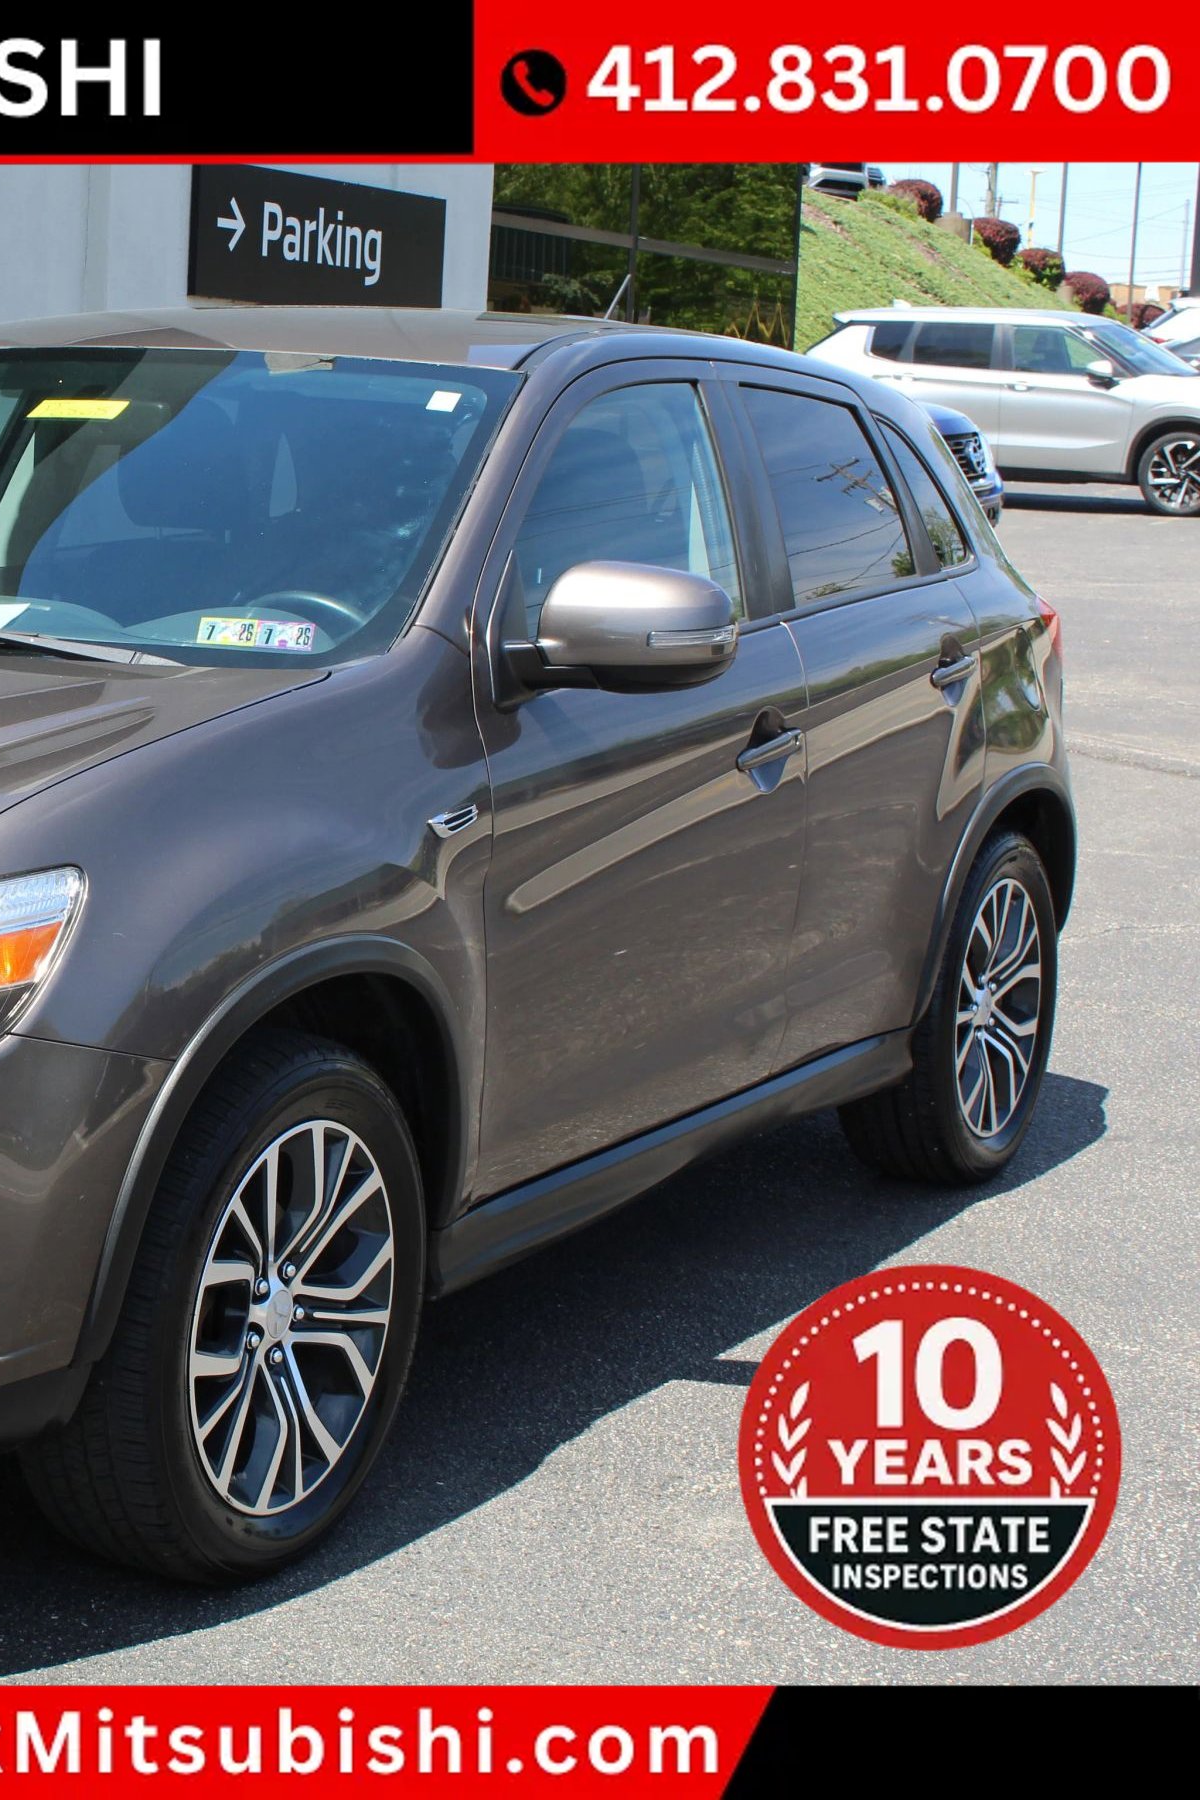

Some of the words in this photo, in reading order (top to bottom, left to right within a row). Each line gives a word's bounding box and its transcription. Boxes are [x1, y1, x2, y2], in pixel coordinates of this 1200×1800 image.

[261, 201, 382, 286] Parking
[206, 624, 216, 641] 7
[238, 623, 255, 642] 26
[264, 628, 274, 645] 7
